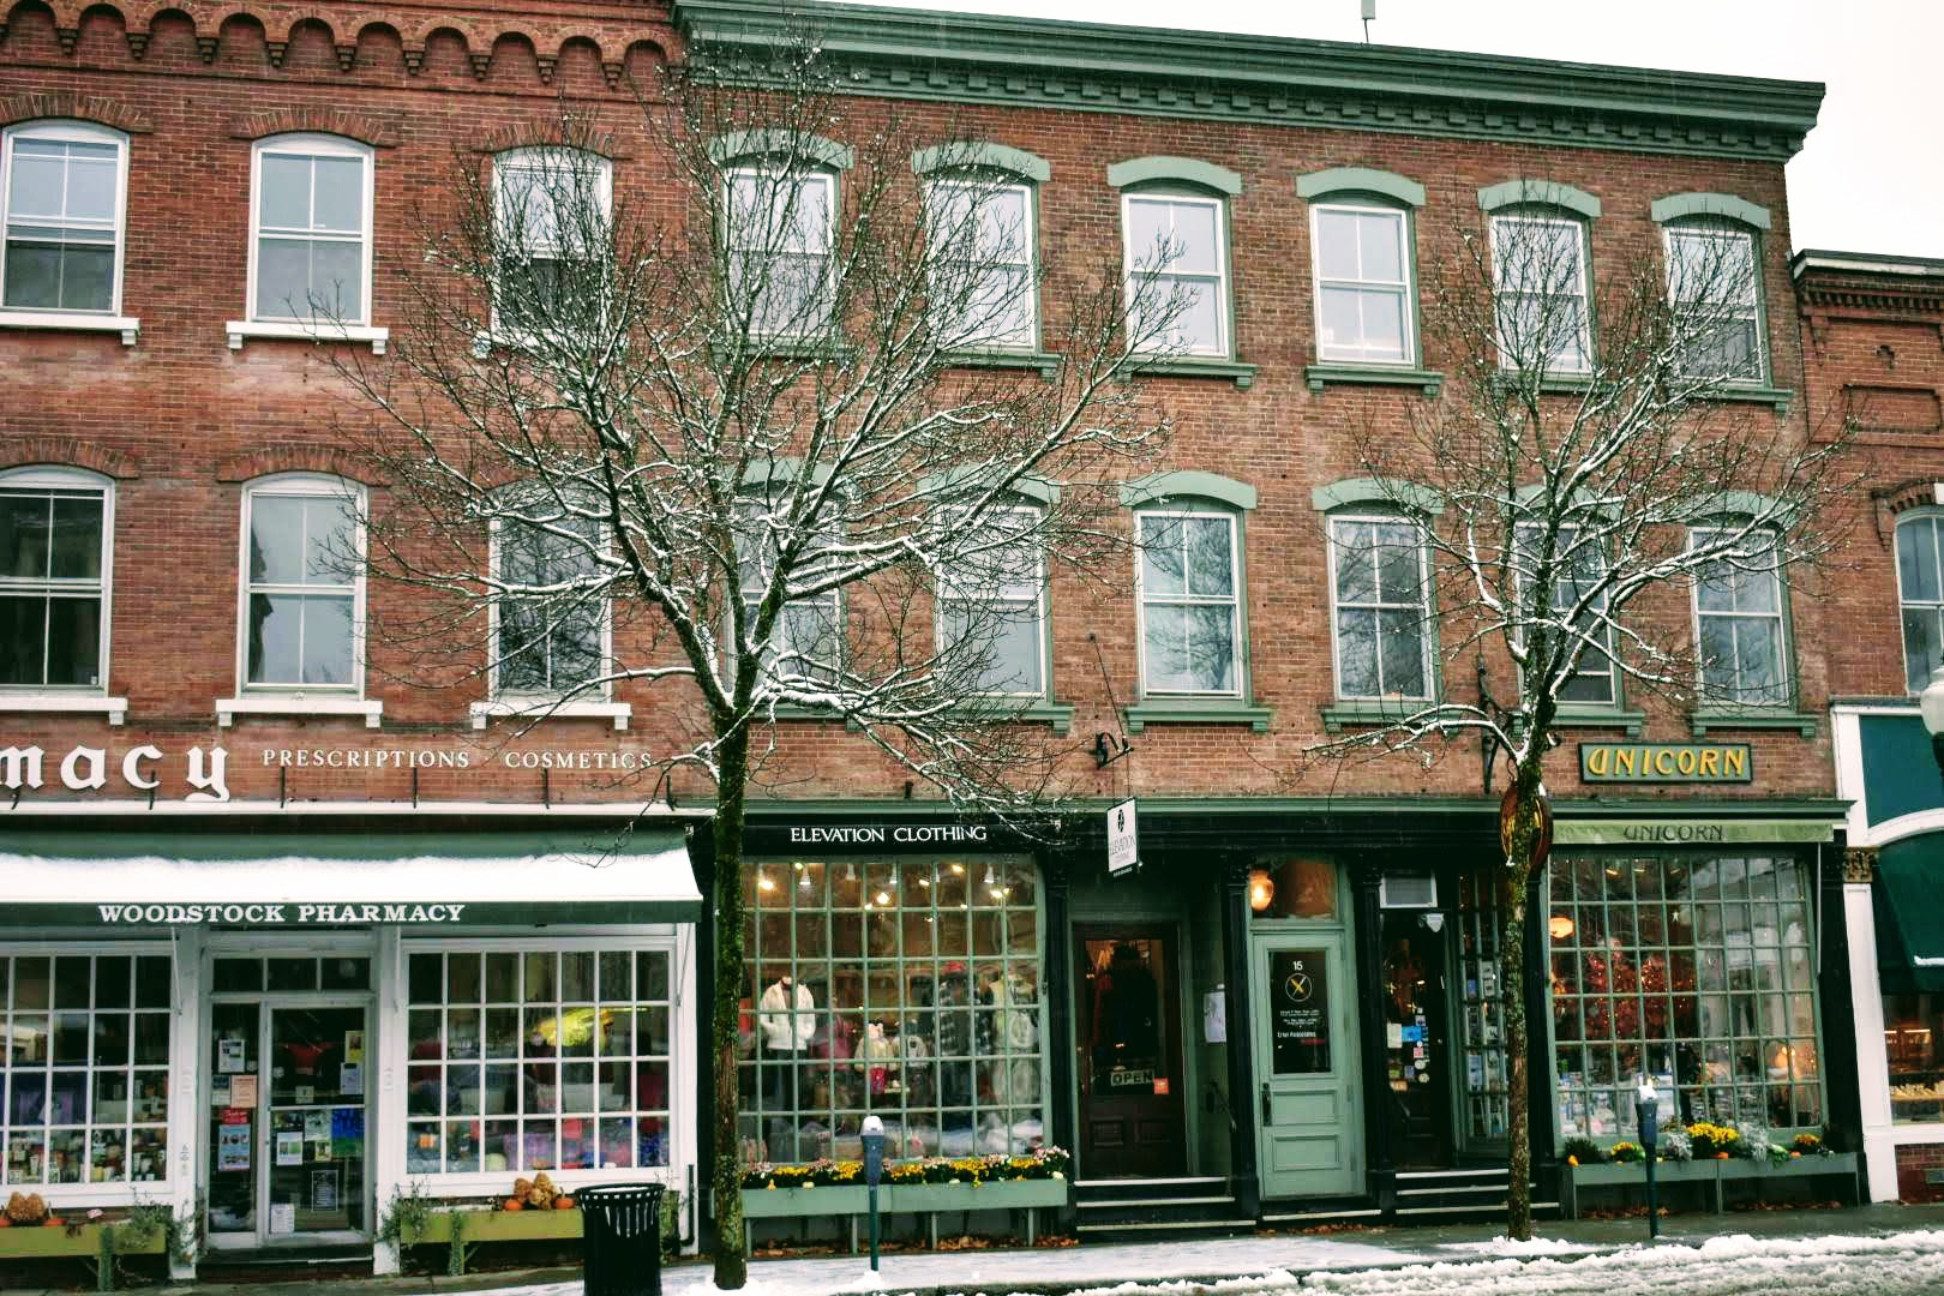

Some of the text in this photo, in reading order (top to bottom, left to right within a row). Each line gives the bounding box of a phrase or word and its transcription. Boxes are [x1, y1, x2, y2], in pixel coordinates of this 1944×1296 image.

[262, 749, 652, 769] PRESCRIPTIONS COSMETICS
[1588, 747, 1745, 776] UNICORN
[790, 826, 987, 843] ELEVATION CLOTHING
[1623, 824, 1724, 842] UNICORN
[99, 904, 465, 923] WOODSTOCK PHARMACY
[1293, 960, 1303, 971] 15
[1112, 1071, 1153, 1084] OPEN
